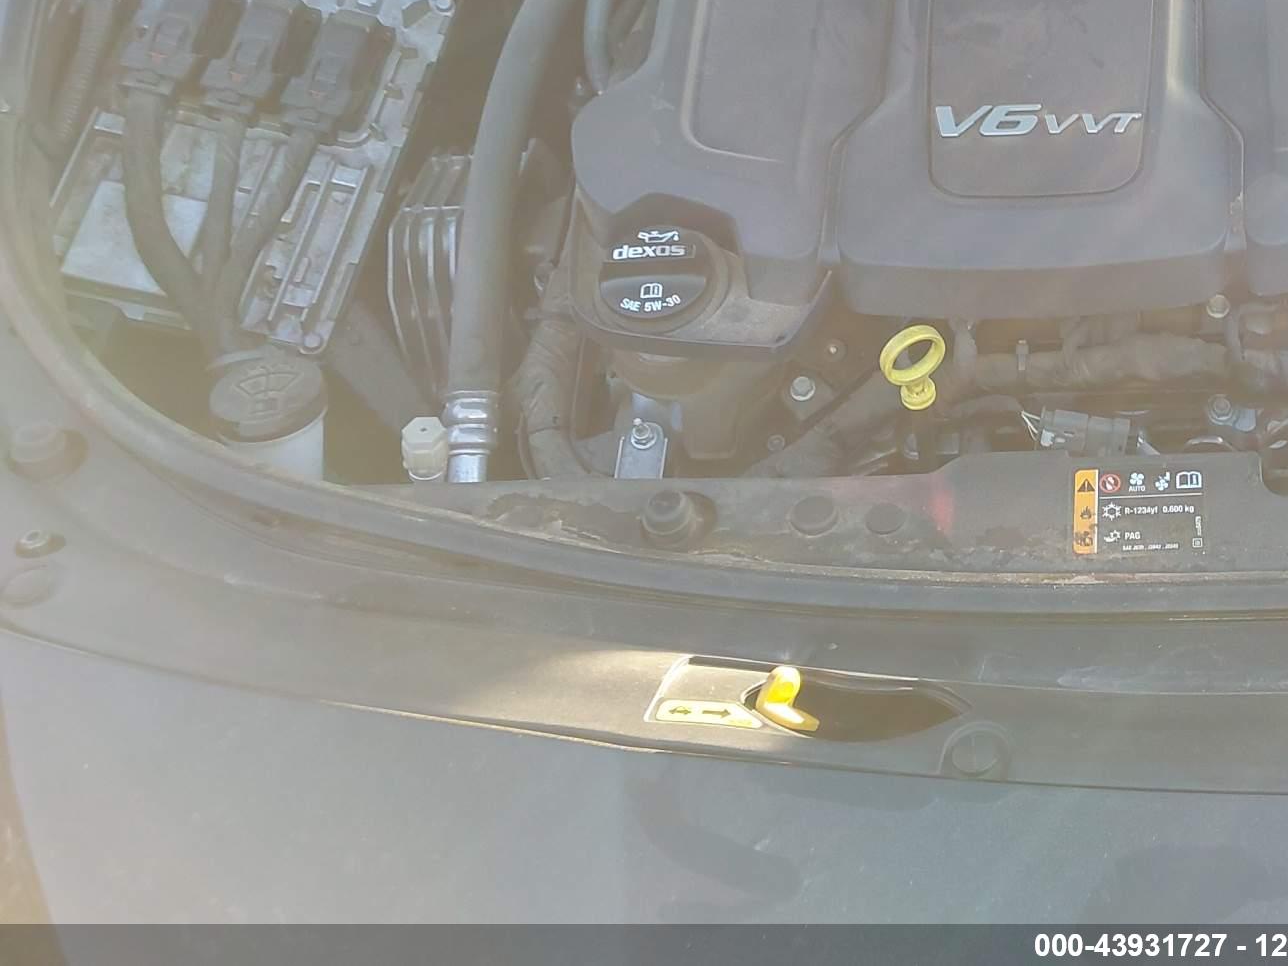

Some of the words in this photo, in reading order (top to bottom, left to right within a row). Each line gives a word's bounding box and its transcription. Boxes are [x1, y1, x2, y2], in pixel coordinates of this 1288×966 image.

[935, 103, 1042, 138] V6
[1044, 113, 1143, 134] VVT
[612, 244, 686, 260] dexos
[620, 298, 642, 312] SAE
[644, 294, 681, 312] 5W-30
[1124, 505, 1158, 516] R-1234yf
[1185, 504, 1195, 514] kg
[1124, 531, 1141, 540] PAG
